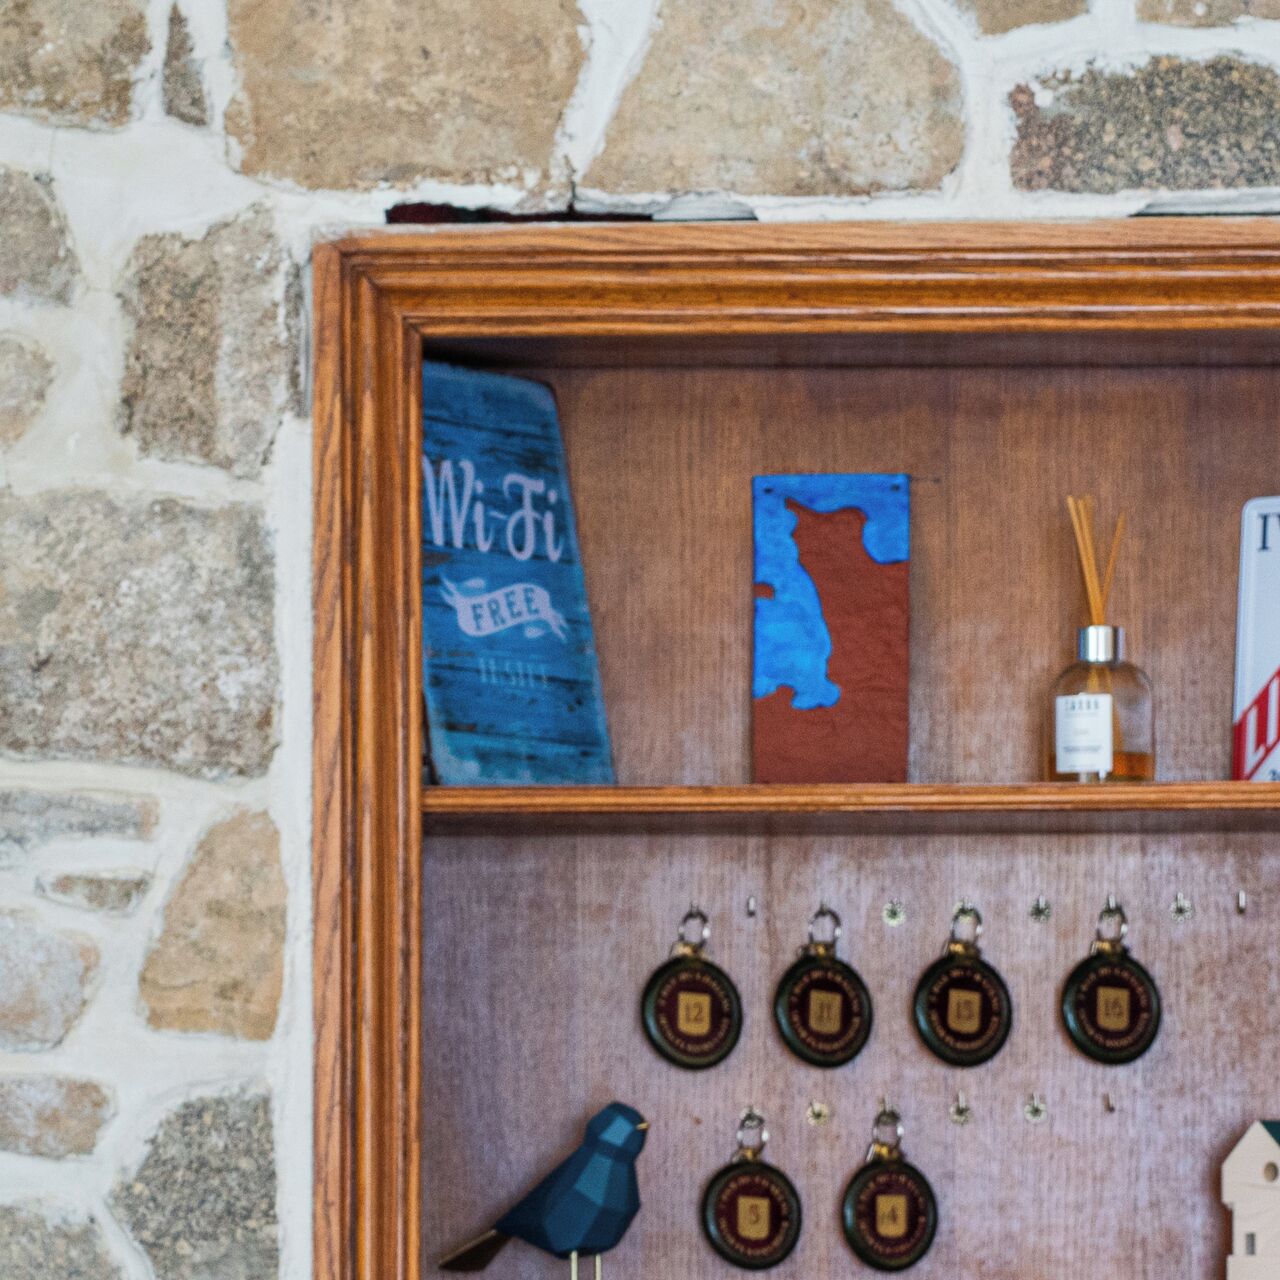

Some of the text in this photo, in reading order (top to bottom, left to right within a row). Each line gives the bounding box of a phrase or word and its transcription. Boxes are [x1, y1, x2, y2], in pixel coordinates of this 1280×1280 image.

[422, 455, 563, 562] Wi-Fi
[471, 587, 541, 632] FREE
[685, 1001, 703, 1024] 12
